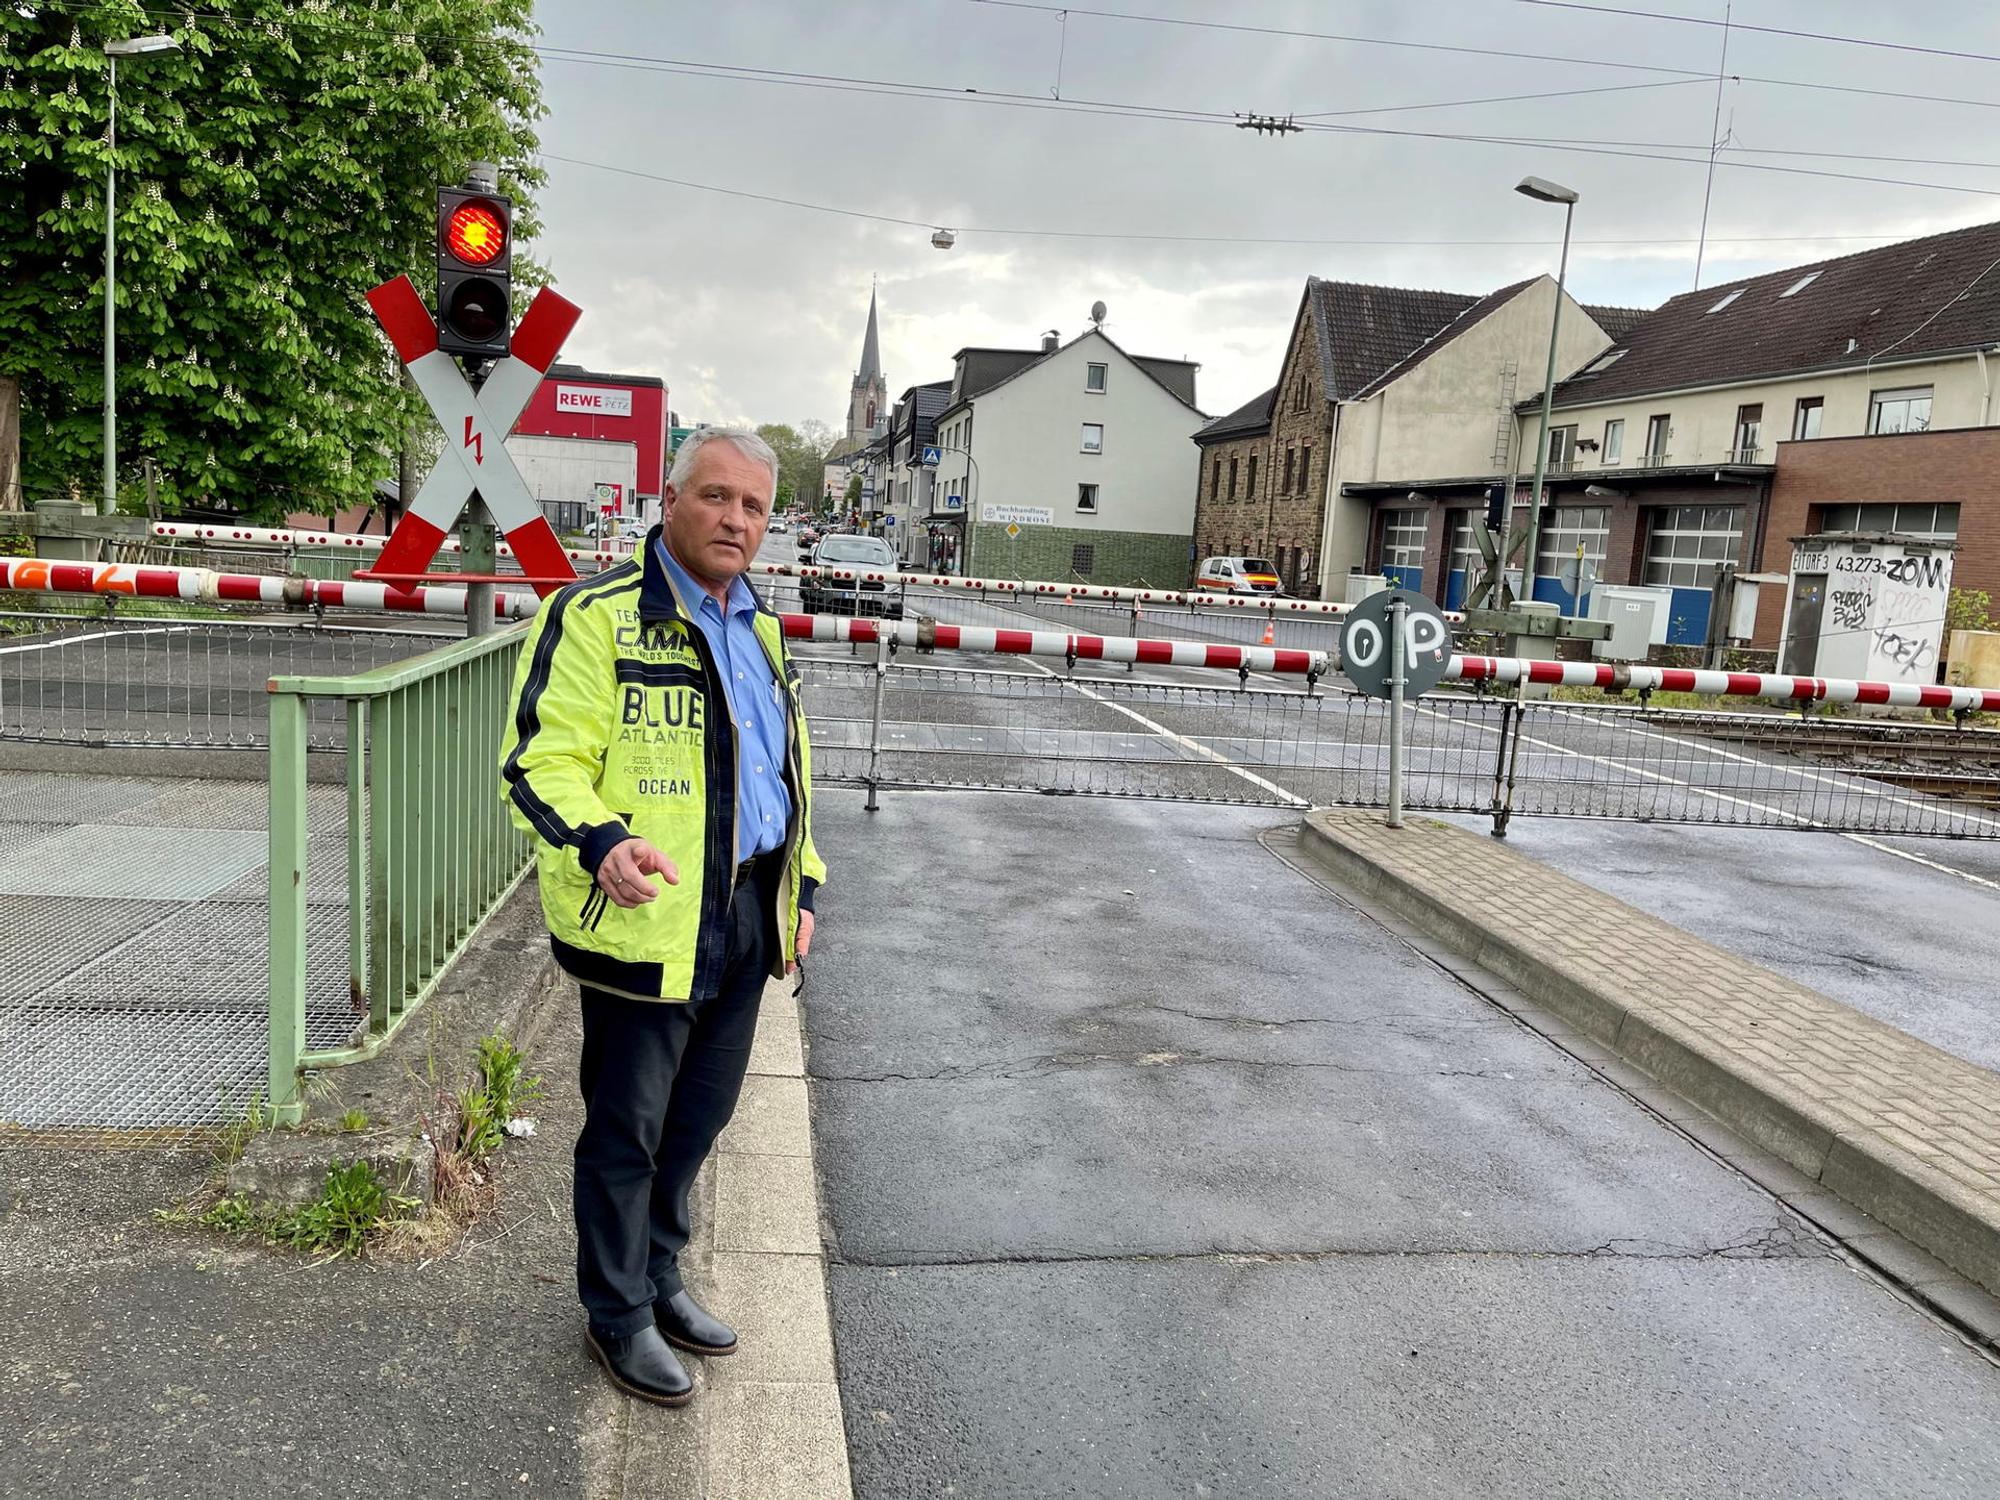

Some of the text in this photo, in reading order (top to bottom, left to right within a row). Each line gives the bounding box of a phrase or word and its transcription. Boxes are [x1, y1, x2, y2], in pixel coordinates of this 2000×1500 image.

[560, 393, 602, 407] REWE
[605, 400, 629, 410] PETZ
[996, 505, 1049, 516] Buchhandlung
[1793, 554, 1829, 571] EITORF 3
[616, 609, 641, 623] TEA
[620, 647, 635, 656] THE
[666, 652, 701, 667] TOUGHEST
[622, 686, 703, 731] BLUE
[618, 728, 703, 748] ATLANTIC
[638, 779, 690, 795] OCEAN
